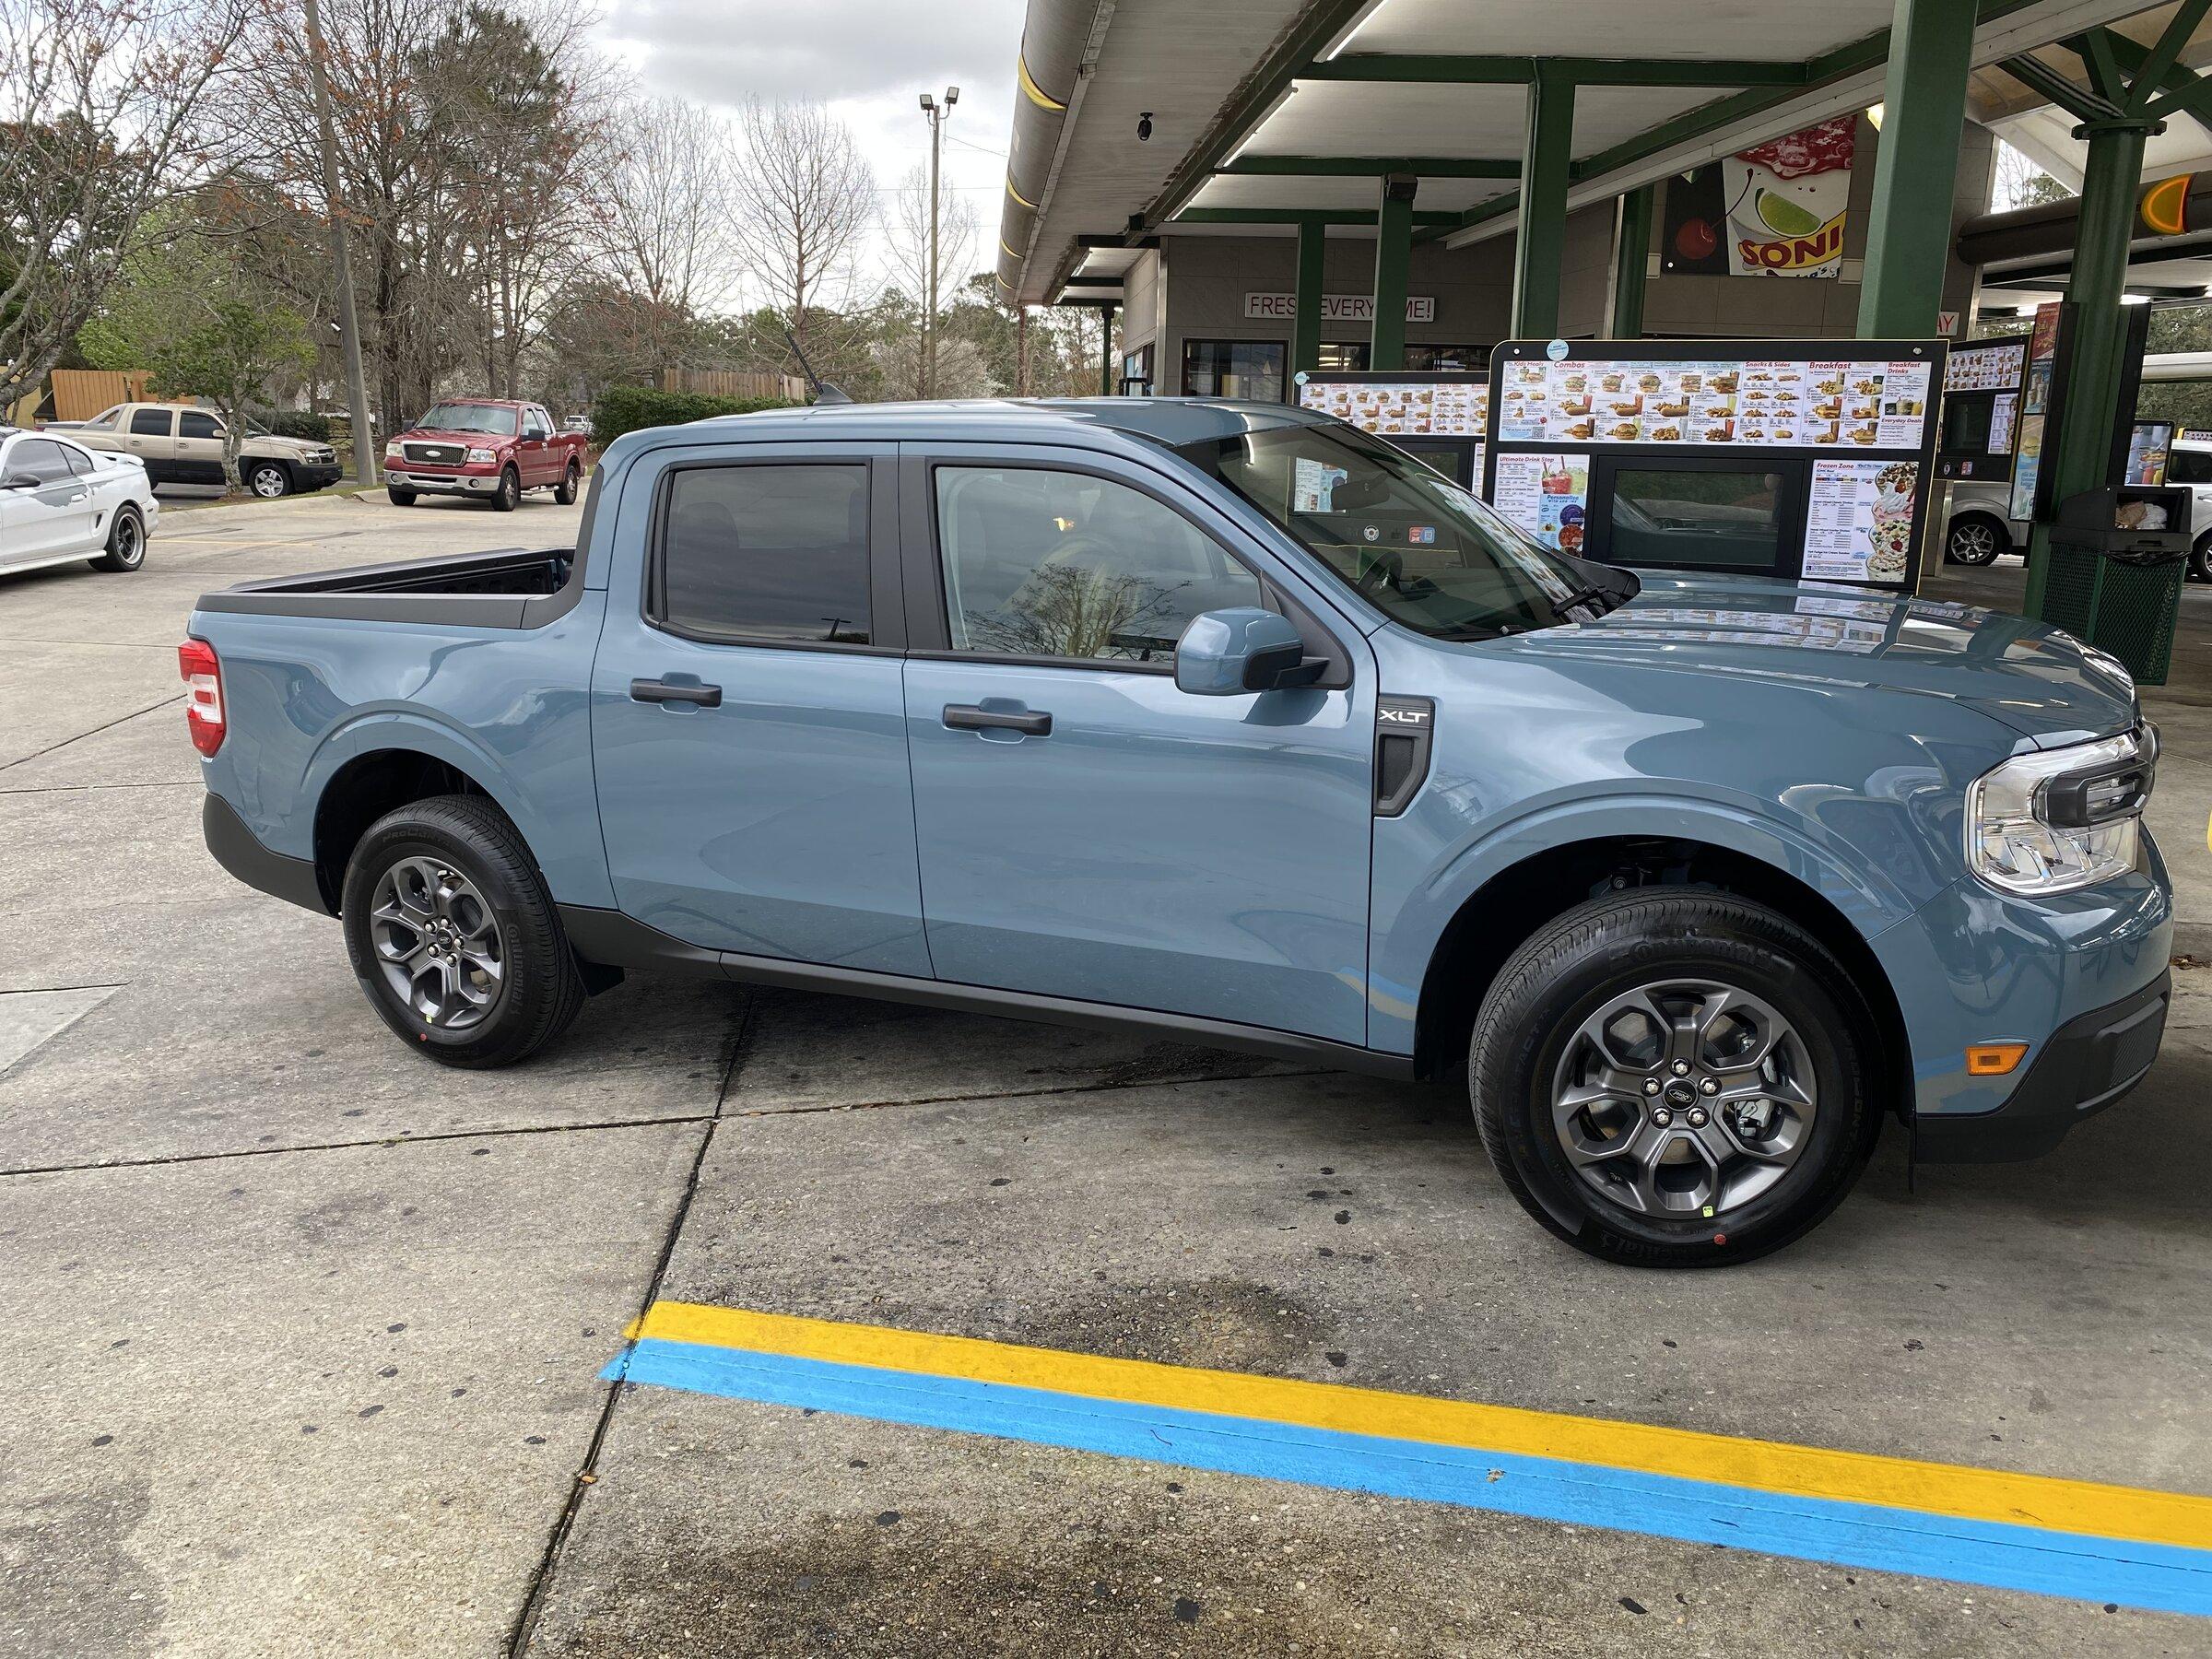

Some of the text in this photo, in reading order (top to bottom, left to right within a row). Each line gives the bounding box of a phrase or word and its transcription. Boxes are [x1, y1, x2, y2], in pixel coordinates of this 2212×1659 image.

[1740, 225, 1841, 269] SONI
[1250, 296, 1297, 315] FRES
[1320, 298, 1375, 317] EVERY
[1808, 361, 1852, 370] Breakfast
[1378, 709, 1429, 724] XLT
